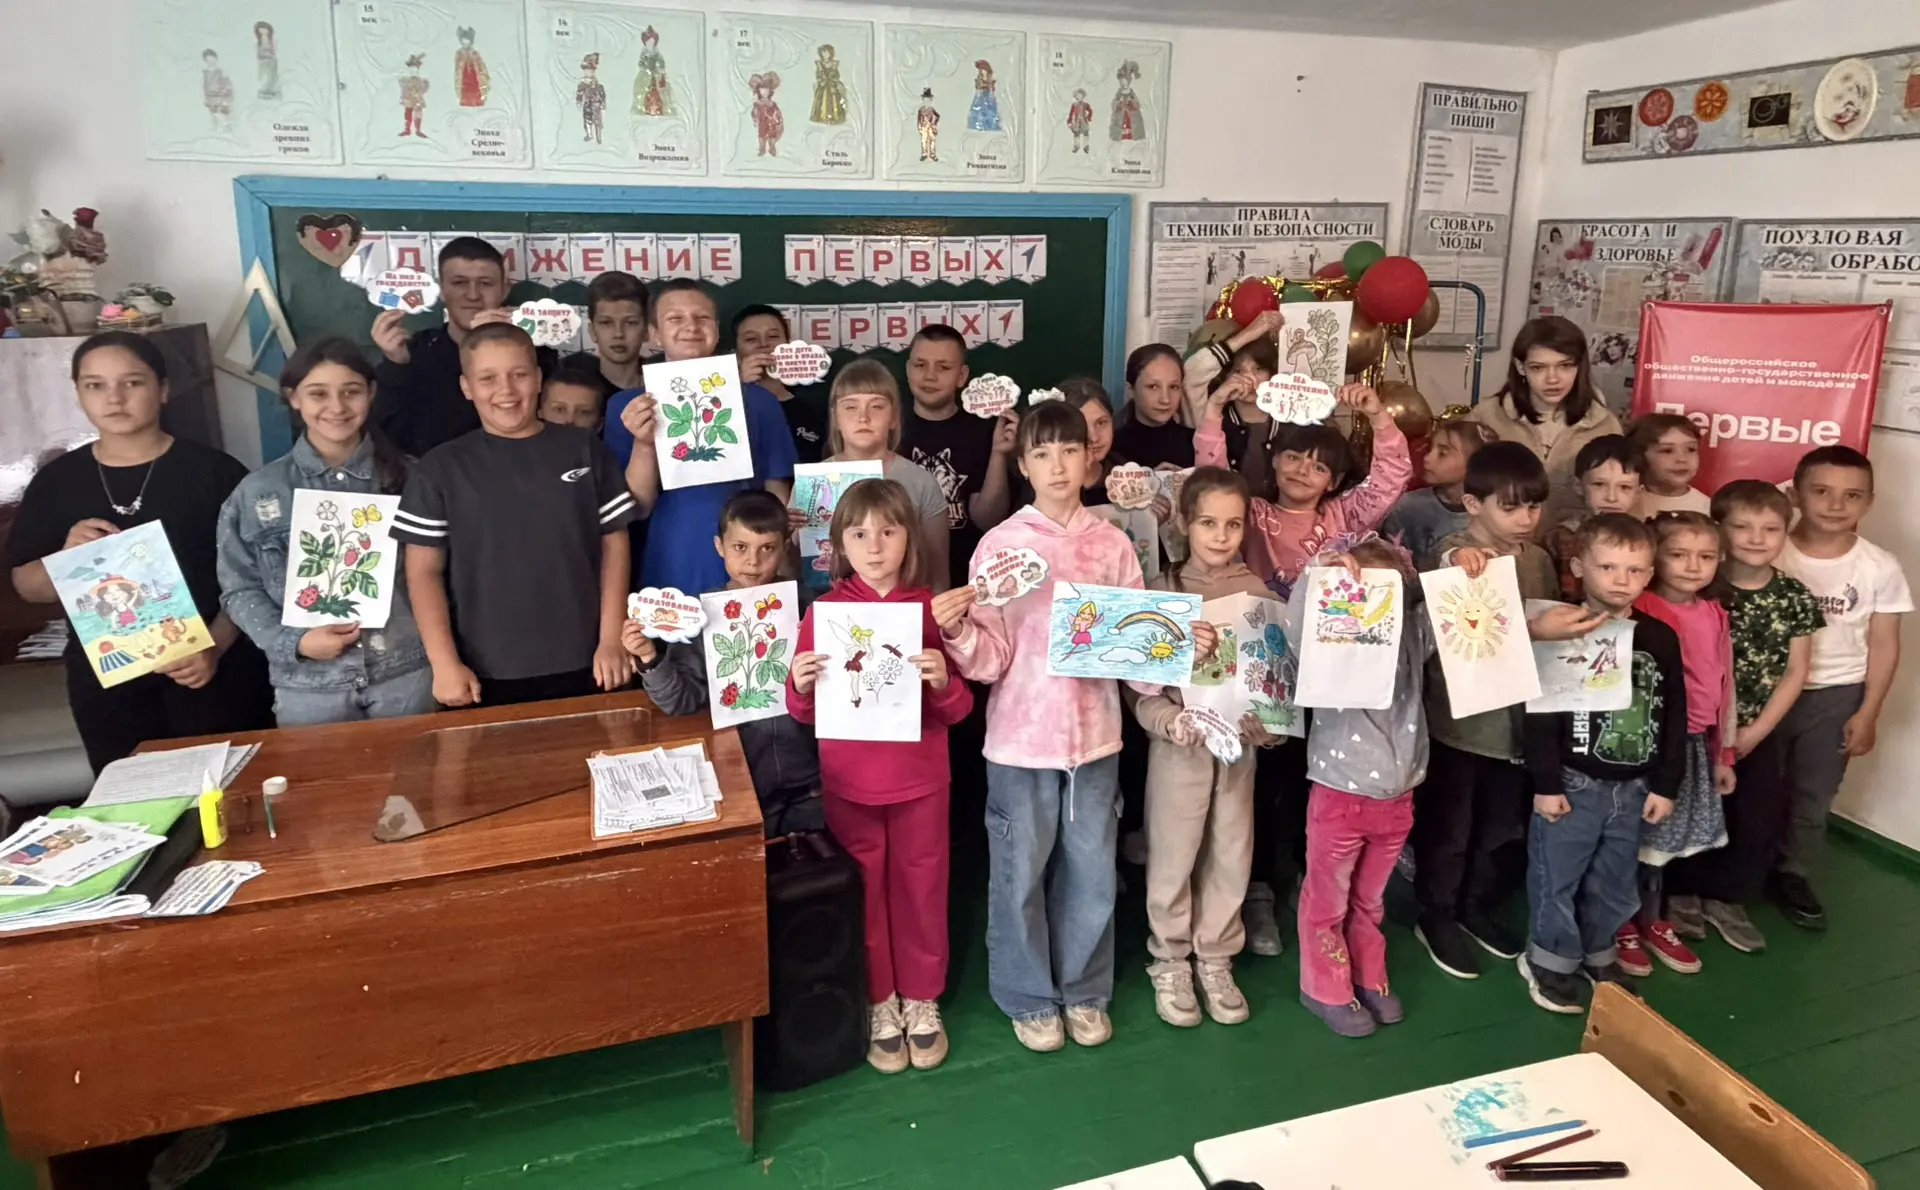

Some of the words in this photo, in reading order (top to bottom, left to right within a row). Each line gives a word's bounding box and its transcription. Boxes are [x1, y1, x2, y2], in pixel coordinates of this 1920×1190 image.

[1432, 93, 1518, 113] ПРАВИЛЬНО
[1451, 114, 1495, 129] ПИШИ
[1237, 208, 1311, 222] ПРАВИЛА
[1165, 223, 1243, 237] ТЕХНИКИ
[1253, 222, 1374, 237] БЕЗОПАСНОСТИ
[1429, 217, 1494, 233] СЛОВАРЬ
[1580, 224, 1650, 238] КРАСОТА
[1665, 224, 1677, 237] И
[1438, 236, 1483, 250] МОДЫ
[794, 248, 1005, 272] ПЕРВЫХ
[1596, 248, 1676, 263] ЗДОРОВЬЕ
[1690, 355, 1818, 369] Общероссийское
[1644, 361, 1871, 380] общественно-государственное
[1652, 373, 1720, 383] движение
[1721, 374, 1764, 385] детей
[1777, 377, 1857, 390] молодёжи
